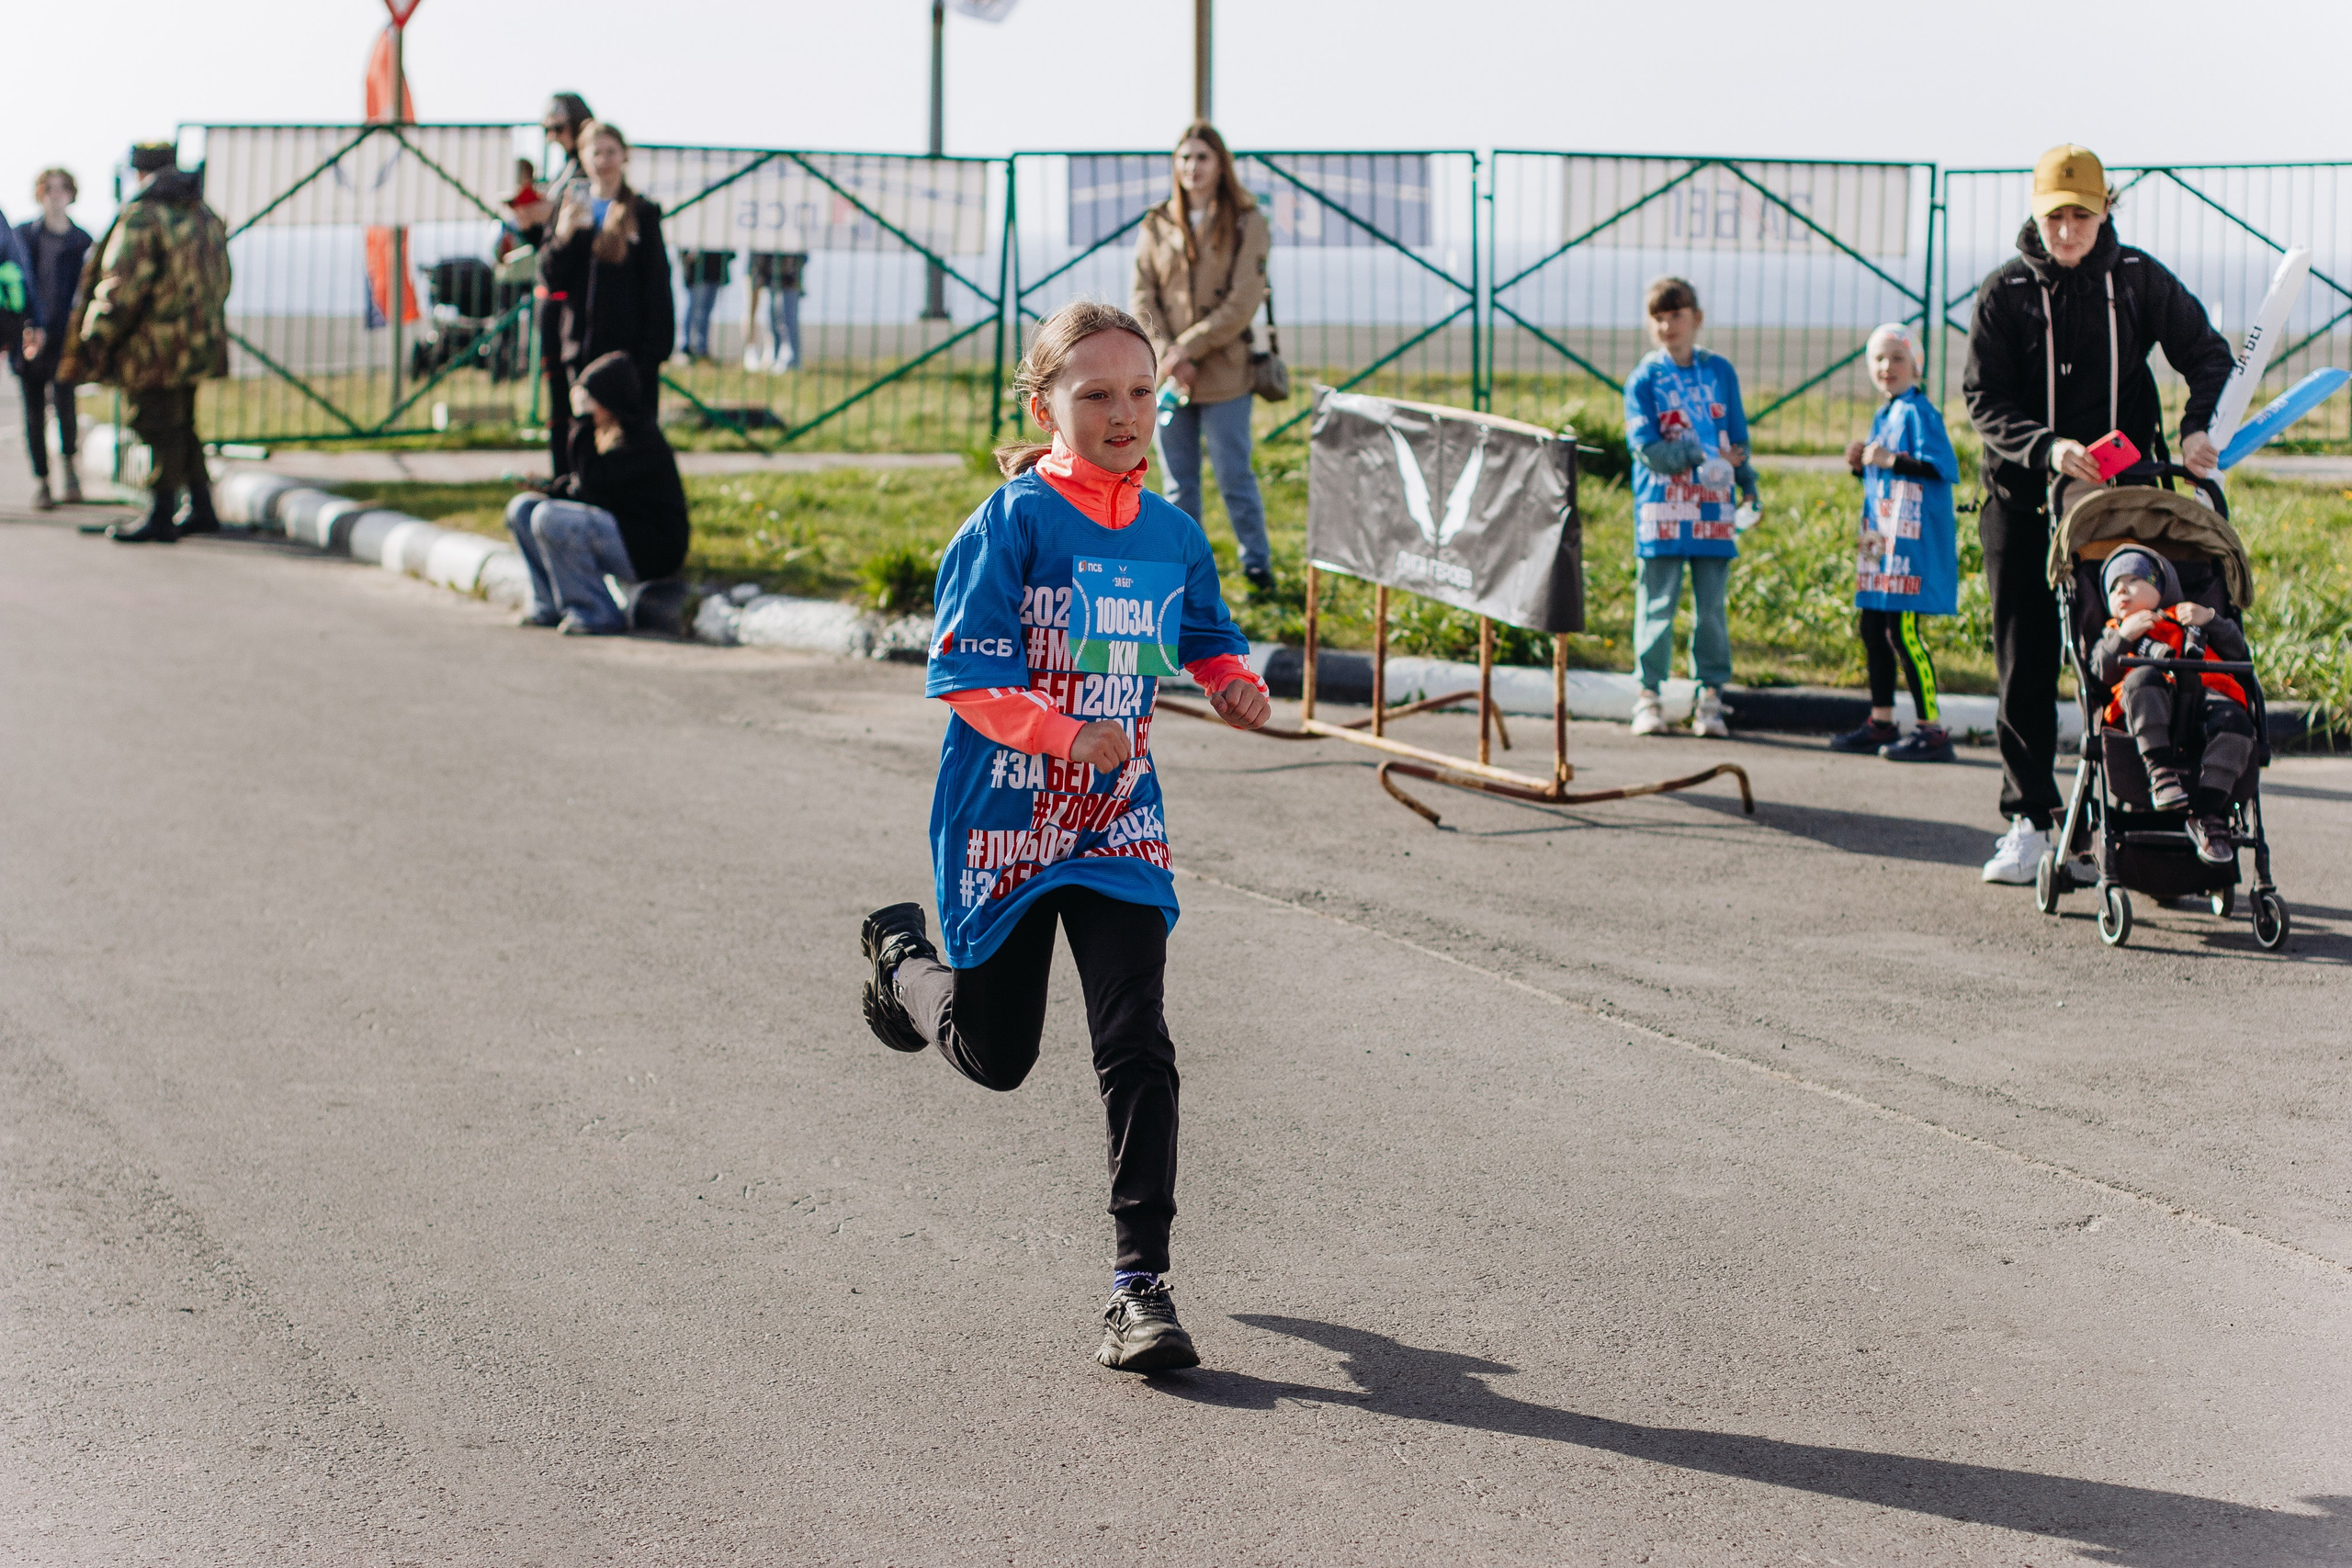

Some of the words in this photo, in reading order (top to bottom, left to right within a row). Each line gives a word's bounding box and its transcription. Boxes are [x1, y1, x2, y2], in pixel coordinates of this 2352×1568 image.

[1087, 562, 1102, 573] ПСБ
[1019, 585, 1072, 627] 202
[1095, 596, 1155, 637] 10034
[960, 637, 1013, 658] ПСБ
[1027, 626, 1081, 671] #М
[1107, 640, 1138, 675] 1КМ
[1082, 673, 1144, 716] 2024
[1107, 804, 1164, 848] 2024
[967, 825, 1078, 870] #ЛЮБОВ
